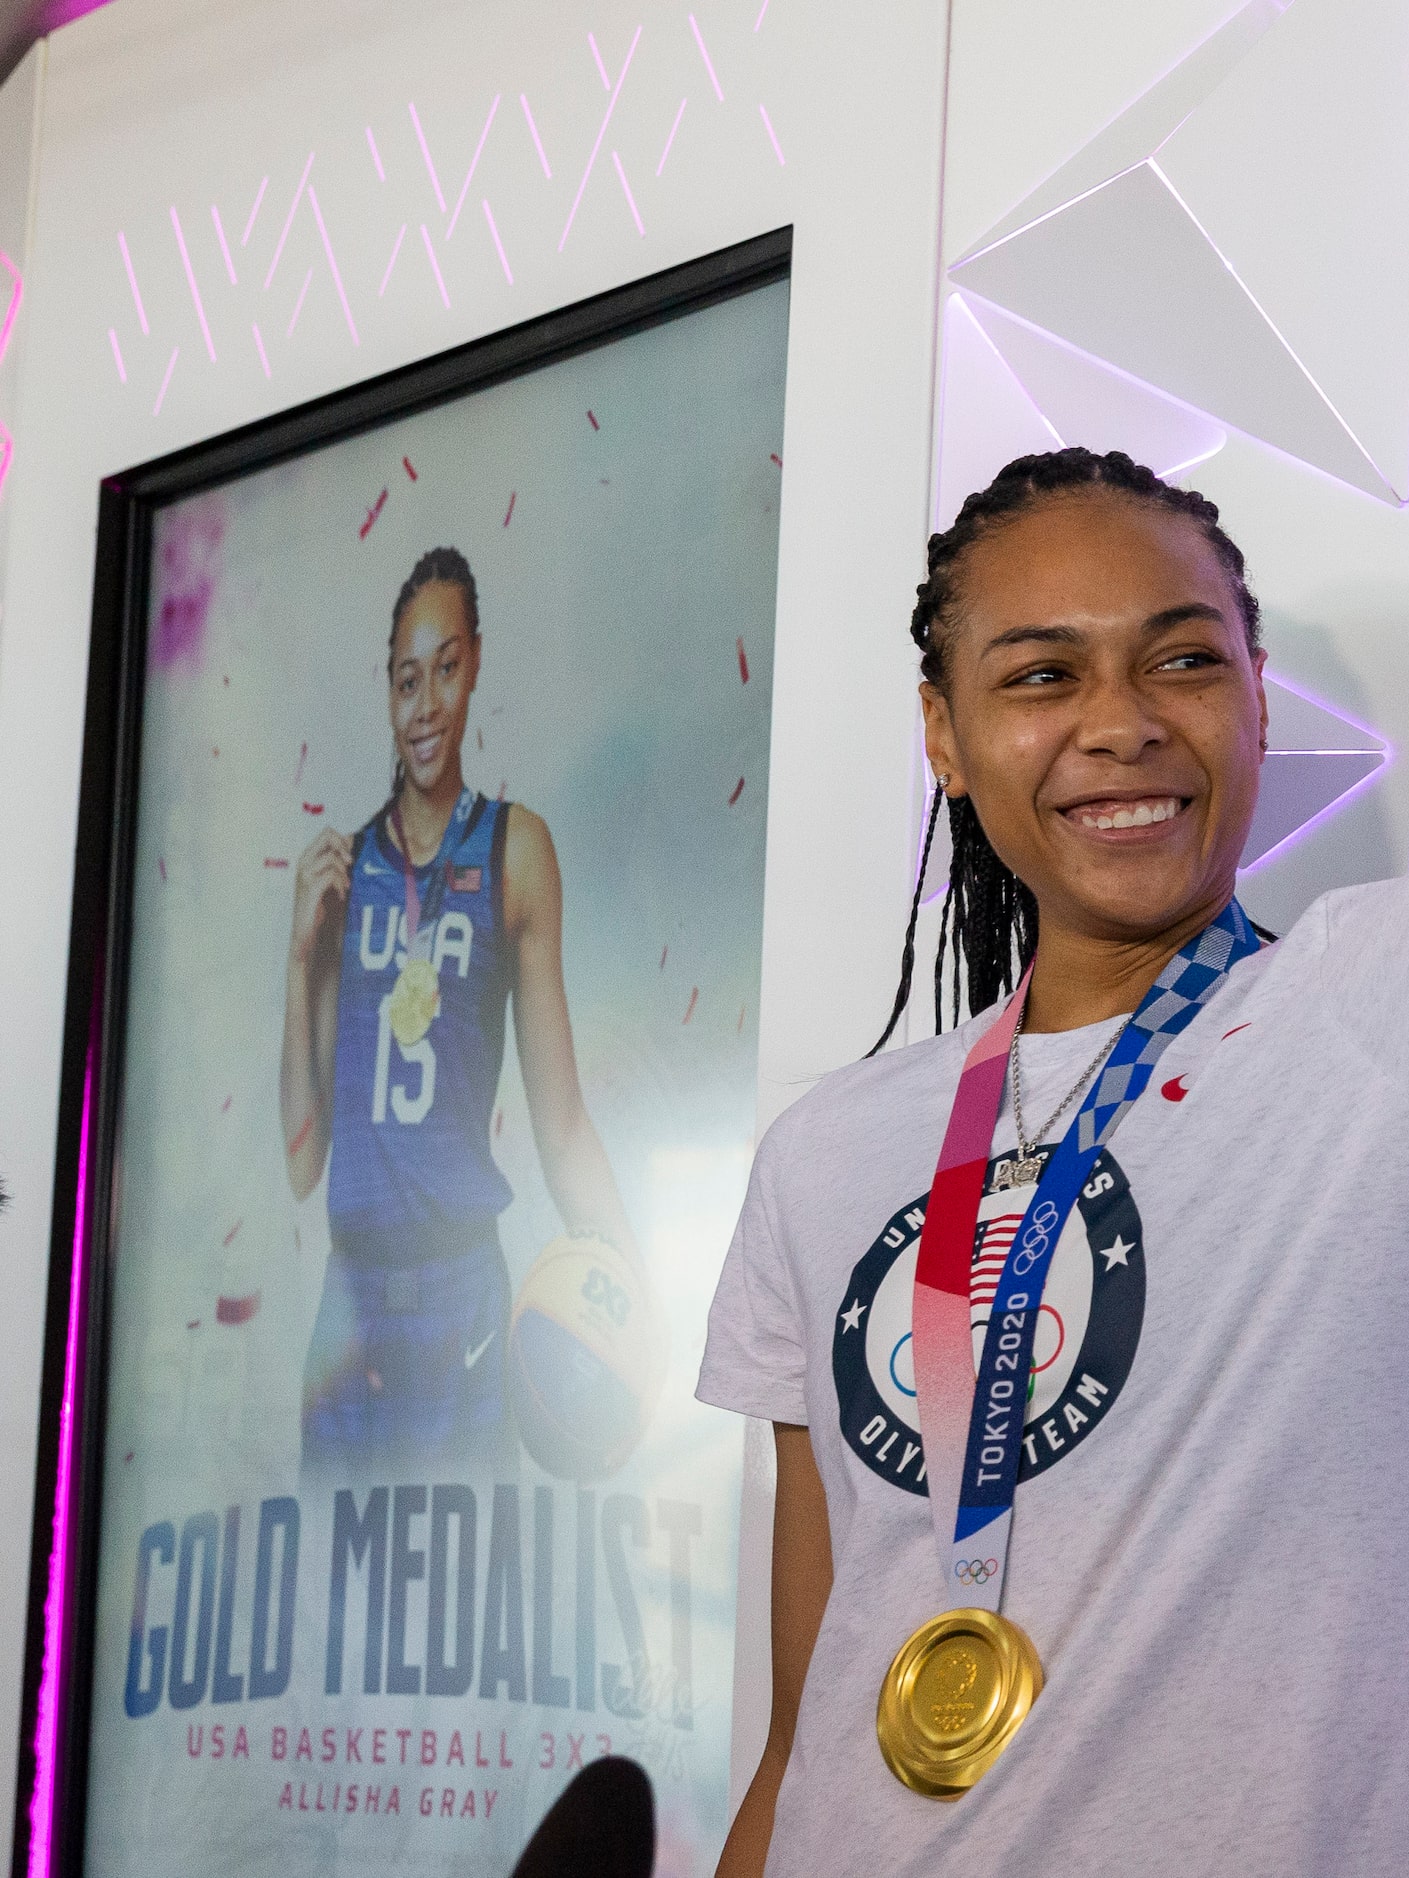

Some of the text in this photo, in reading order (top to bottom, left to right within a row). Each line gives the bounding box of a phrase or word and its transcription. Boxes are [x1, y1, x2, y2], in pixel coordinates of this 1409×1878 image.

[977, 1291, 1030, 1487] TOKYO 2020
[1022, 1372, 1110, 1465] TEAM
[124, 1482, 702, 1732] GOLD MEDALIST
[186, 1723, 249, 1760] USA
[271, 1725, 514, 1769] BASKETBALL
[278, 1782, 500, 1819] ALLISHA GRAY
